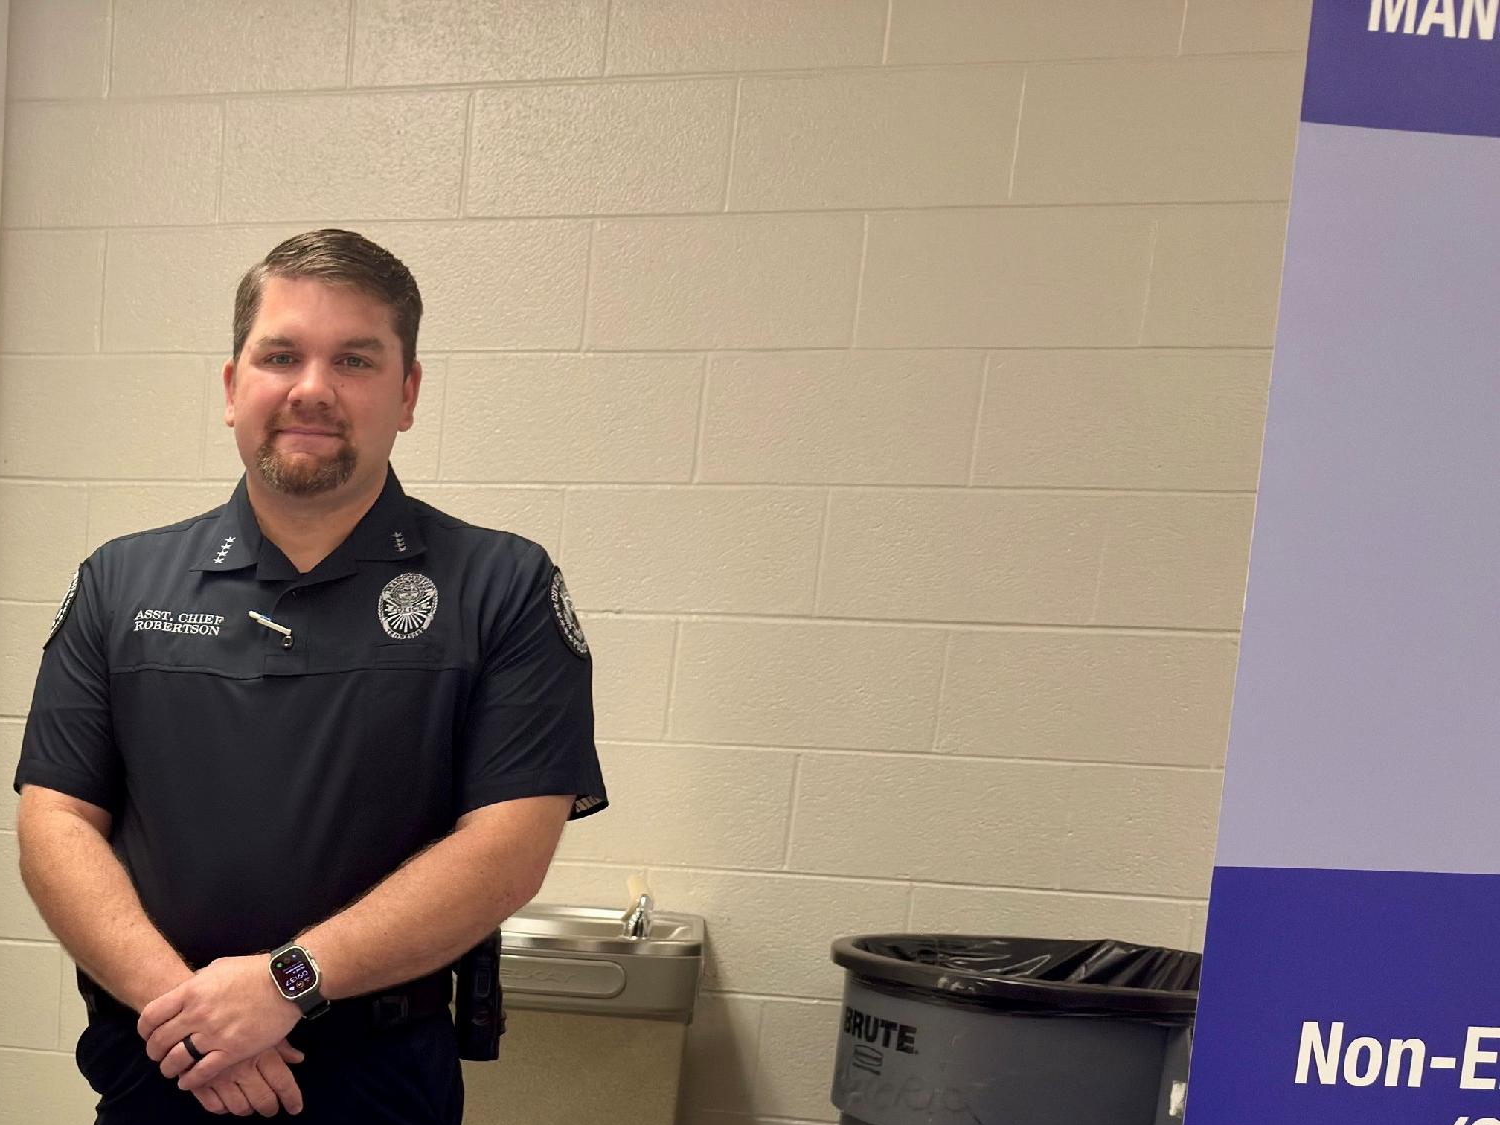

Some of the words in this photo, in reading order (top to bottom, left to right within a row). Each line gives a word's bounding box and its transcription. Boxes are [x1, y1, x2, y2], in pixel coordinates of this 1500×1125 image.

[1367, 0, 1500, 40] MAN
[133, 620, 220, 636] ROBERTSON
[134, 609, 174, 622] ASST.
[178, 613, 224, 625] CHIEF
[844, 1006, 918, 1055] BRUTE
[1294, 1021, 1500, 1090] Non-E
